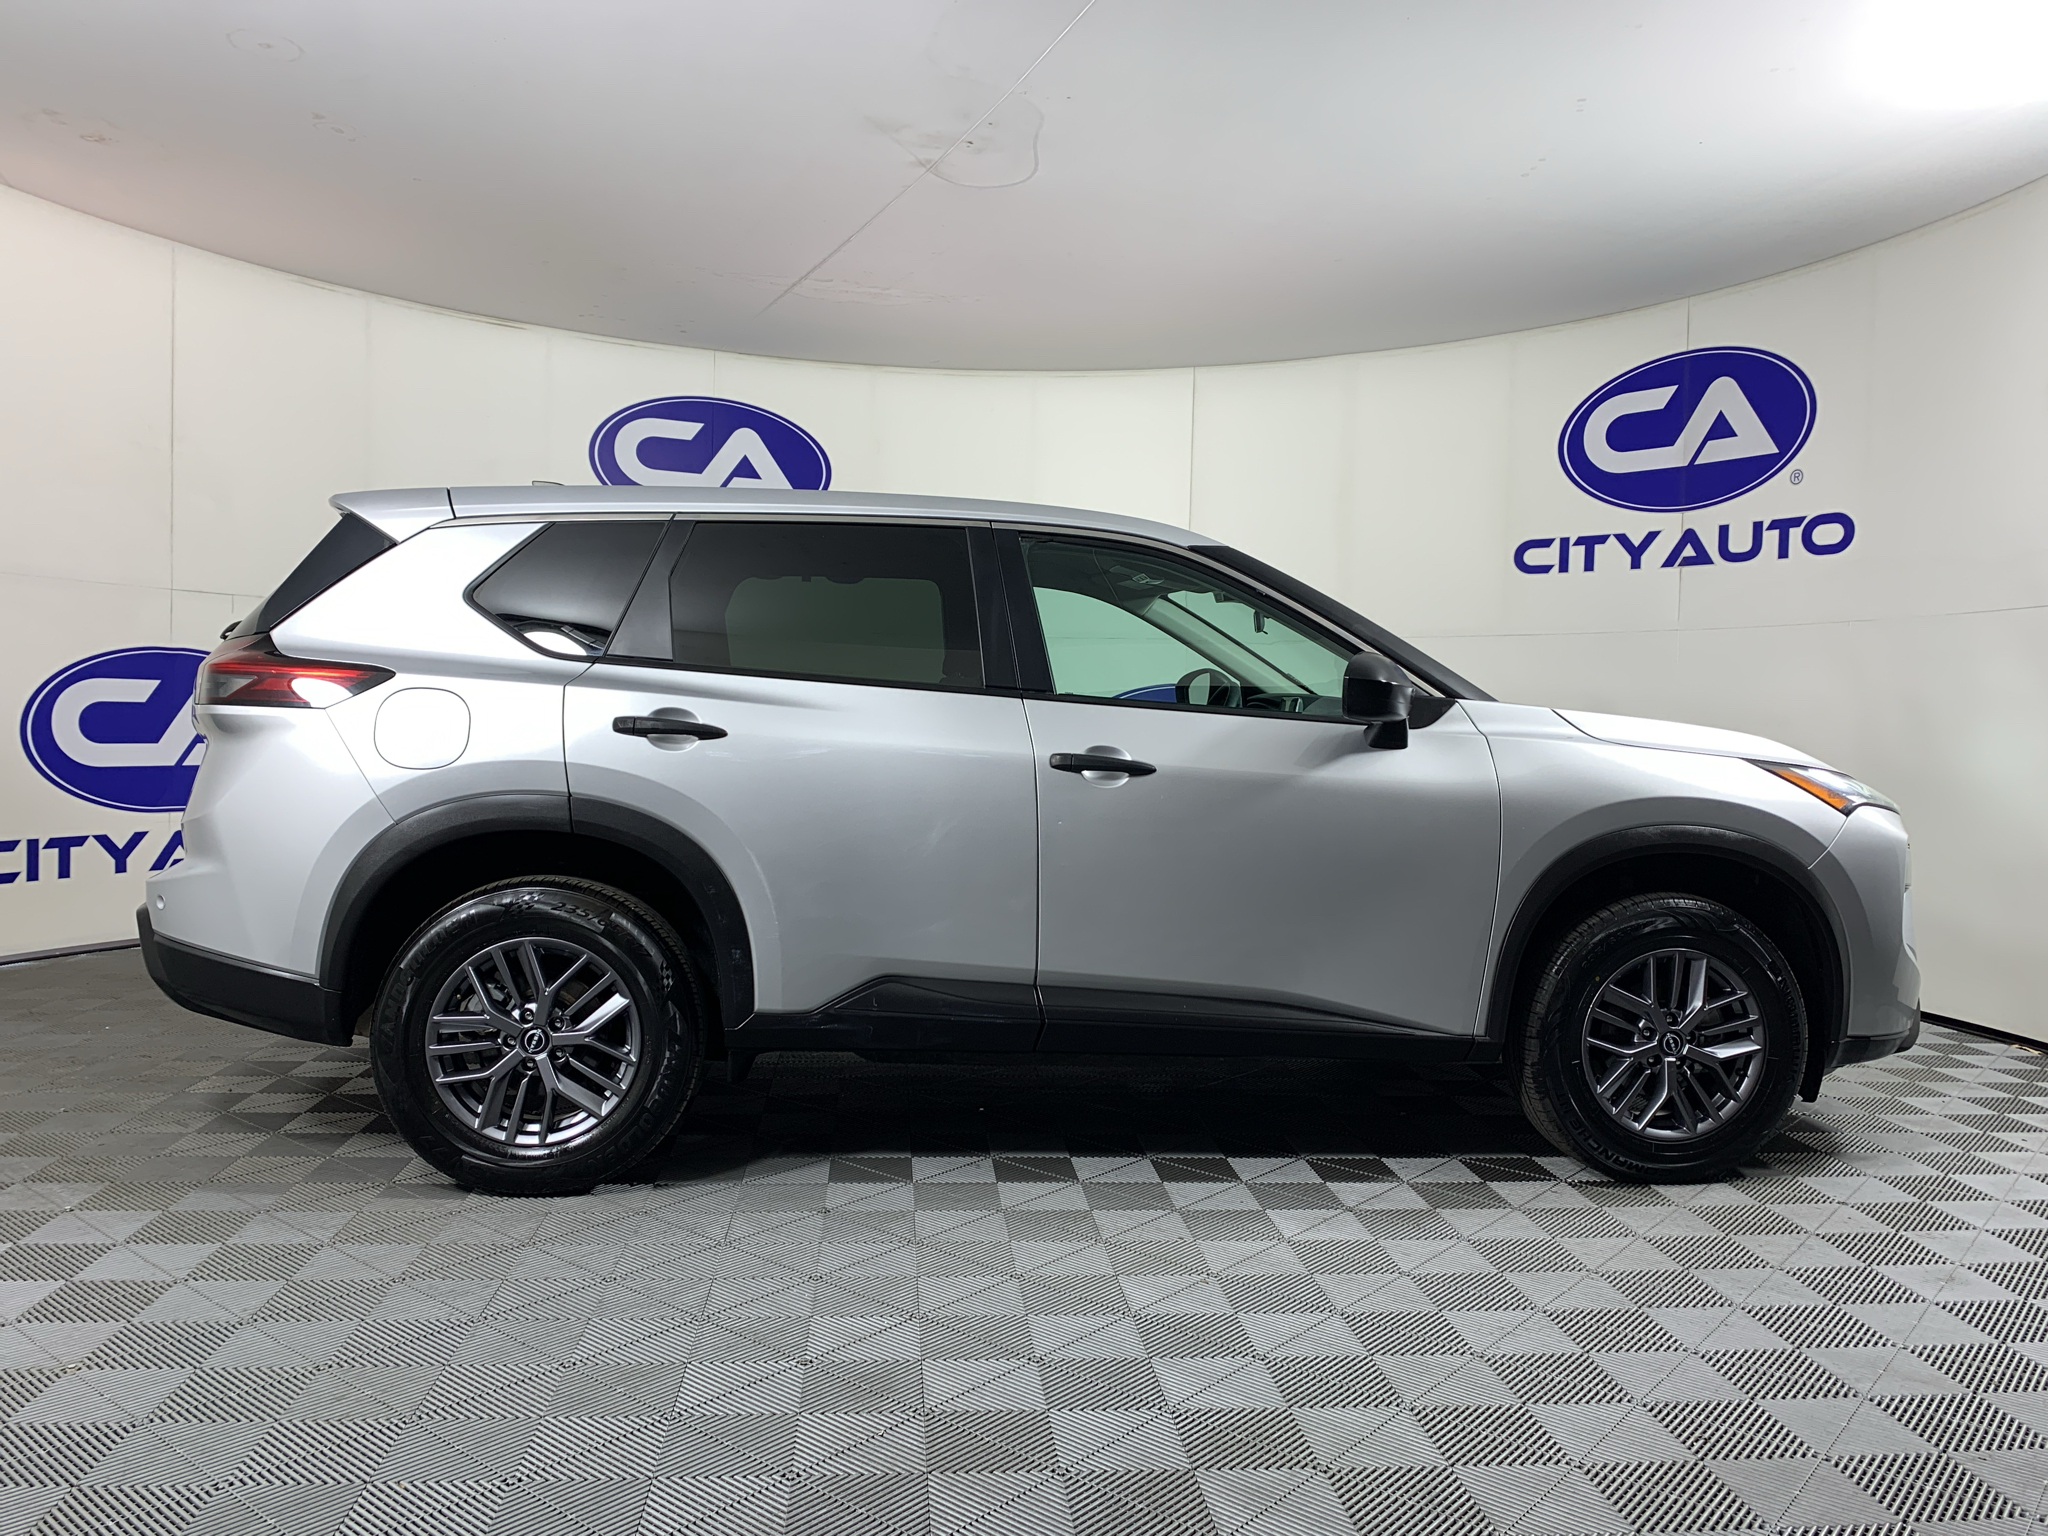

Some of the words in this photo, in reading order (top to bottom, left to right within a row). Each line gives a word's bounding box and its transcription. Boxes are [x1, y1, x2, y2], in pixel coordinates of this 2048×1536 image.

[614, 418, 794, 488] CA
[1584, 376, 1779, 473] CA
[1514, 530, 1662, 574] CITY
[1661, 512, 1855, 567] AUTO
